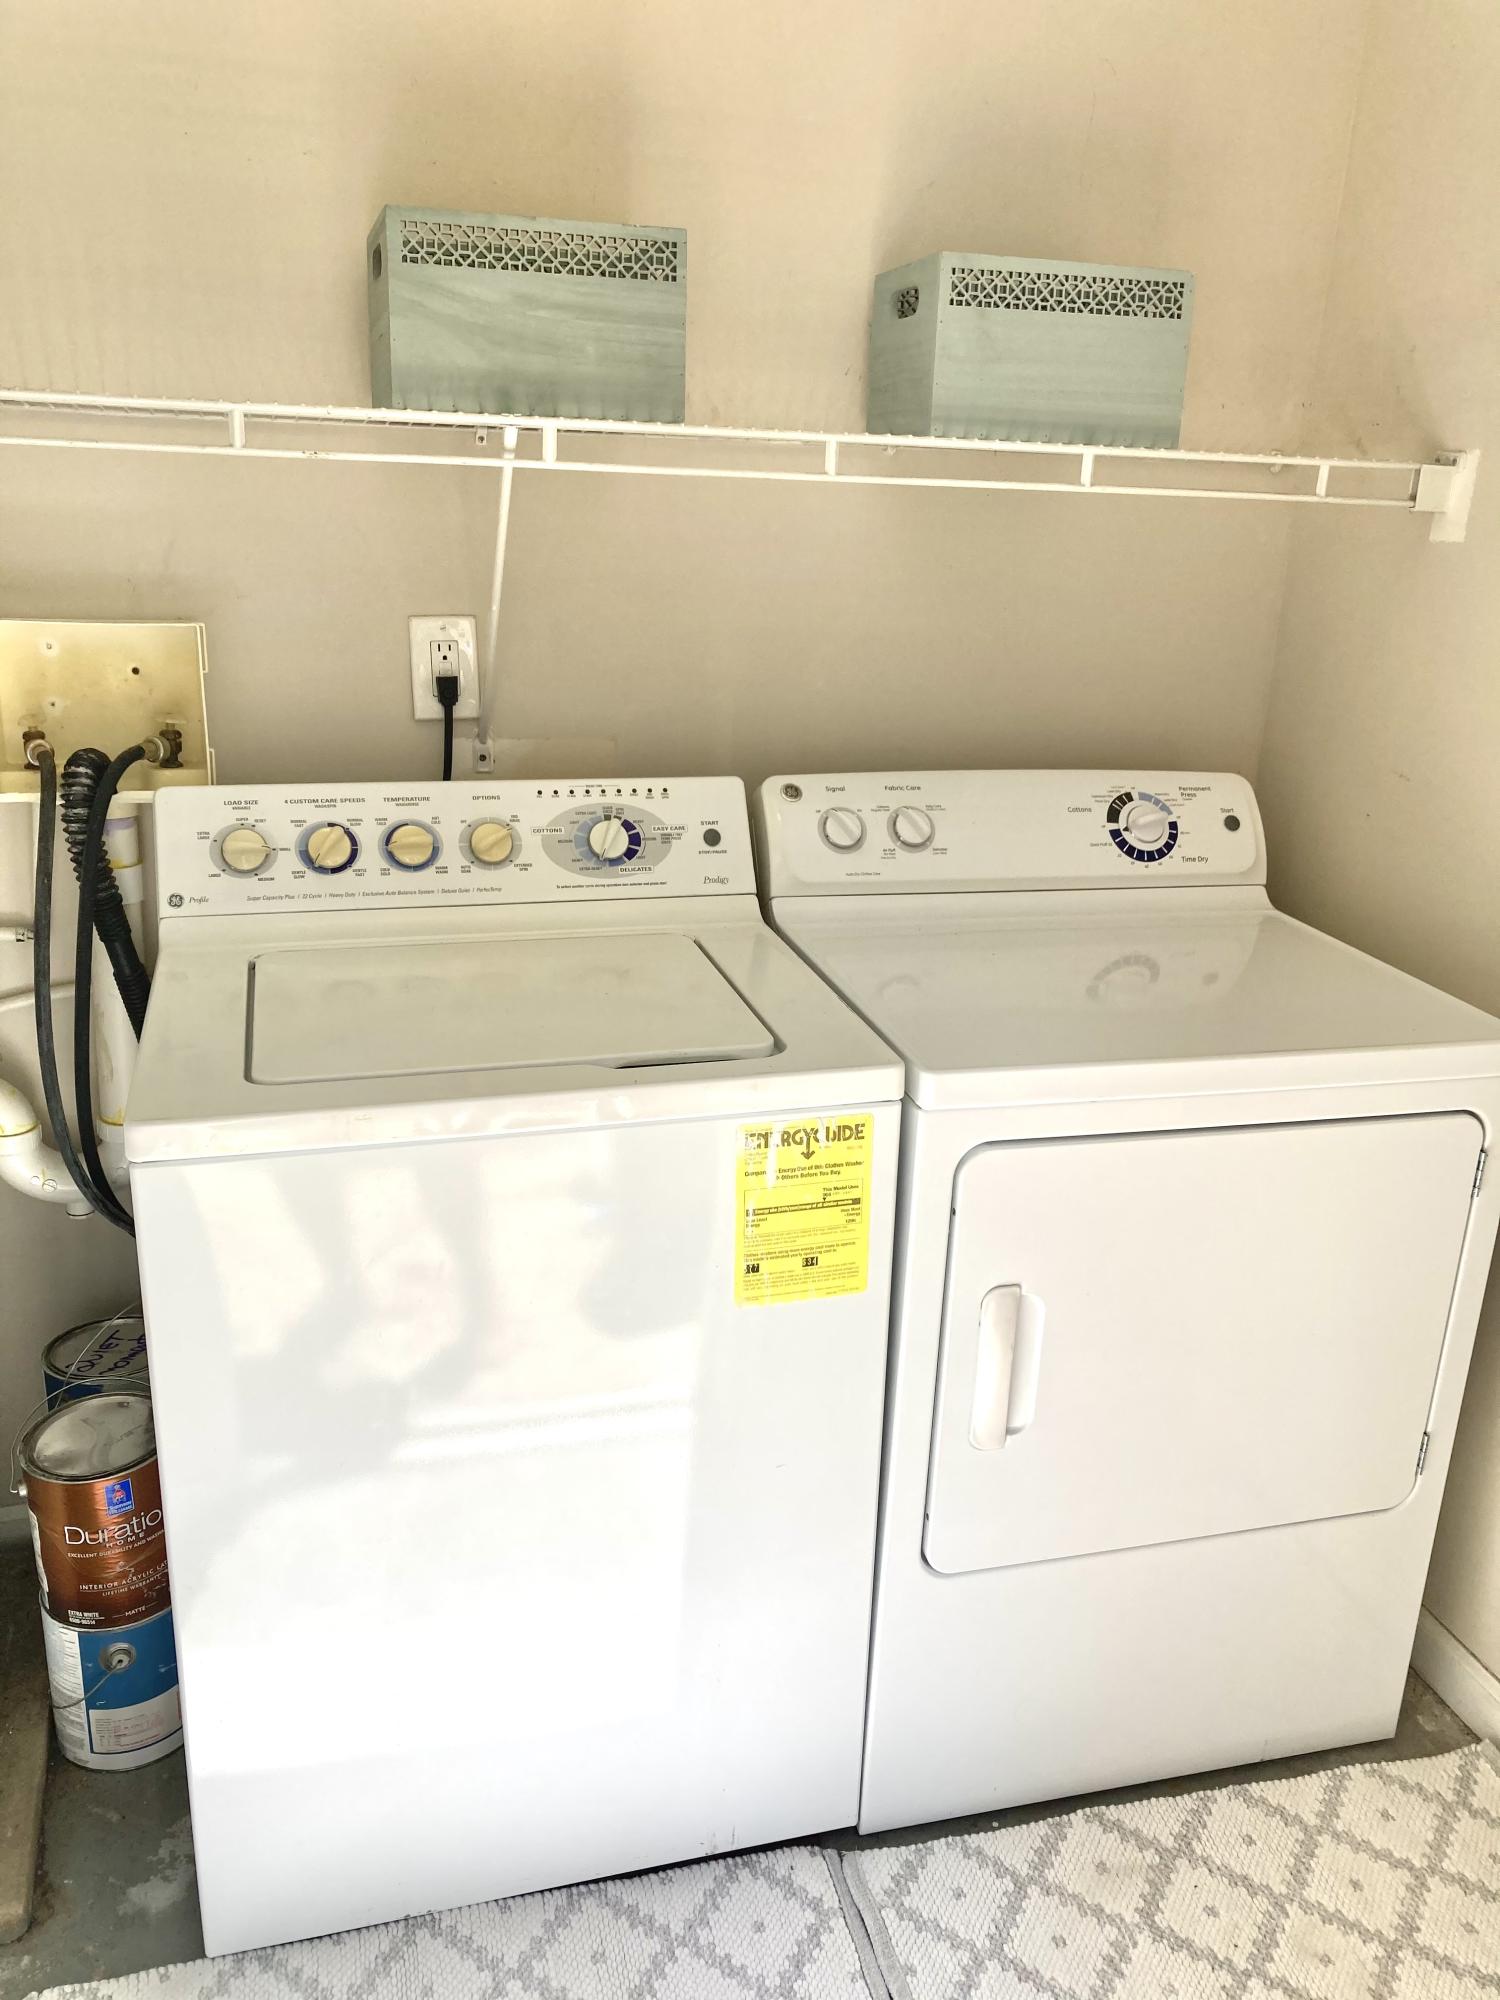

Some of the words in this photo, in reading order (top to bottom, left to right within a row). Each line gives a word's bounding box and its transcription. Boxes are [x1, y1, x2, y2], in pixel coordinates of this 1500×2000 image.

[1198, 856, 1209, 864] Dry
[704, 876, 729, 884] Prodigy
[189, 896, 210, 904] Profile
[65, 1329, 136, 1373] QUIET
[64, 1508, 162, 1545] Duratio
[106, 1532, 145, 1548] HOME
[98, 1544, 134, 1558] DURABILITY
[134, 1538, 147, 1548] AND
[80, 1580, 120, 1590] INTERIOR
[122, 1567, 155, 1584] ACRYLIC
[156, 1559, 168, 1570] LAT
[102, 1587, 129, 1597] LIFETIME
[68, 1609, 83, 1617] EXTRA
[126, 1604, 146, 1617] MATTE
